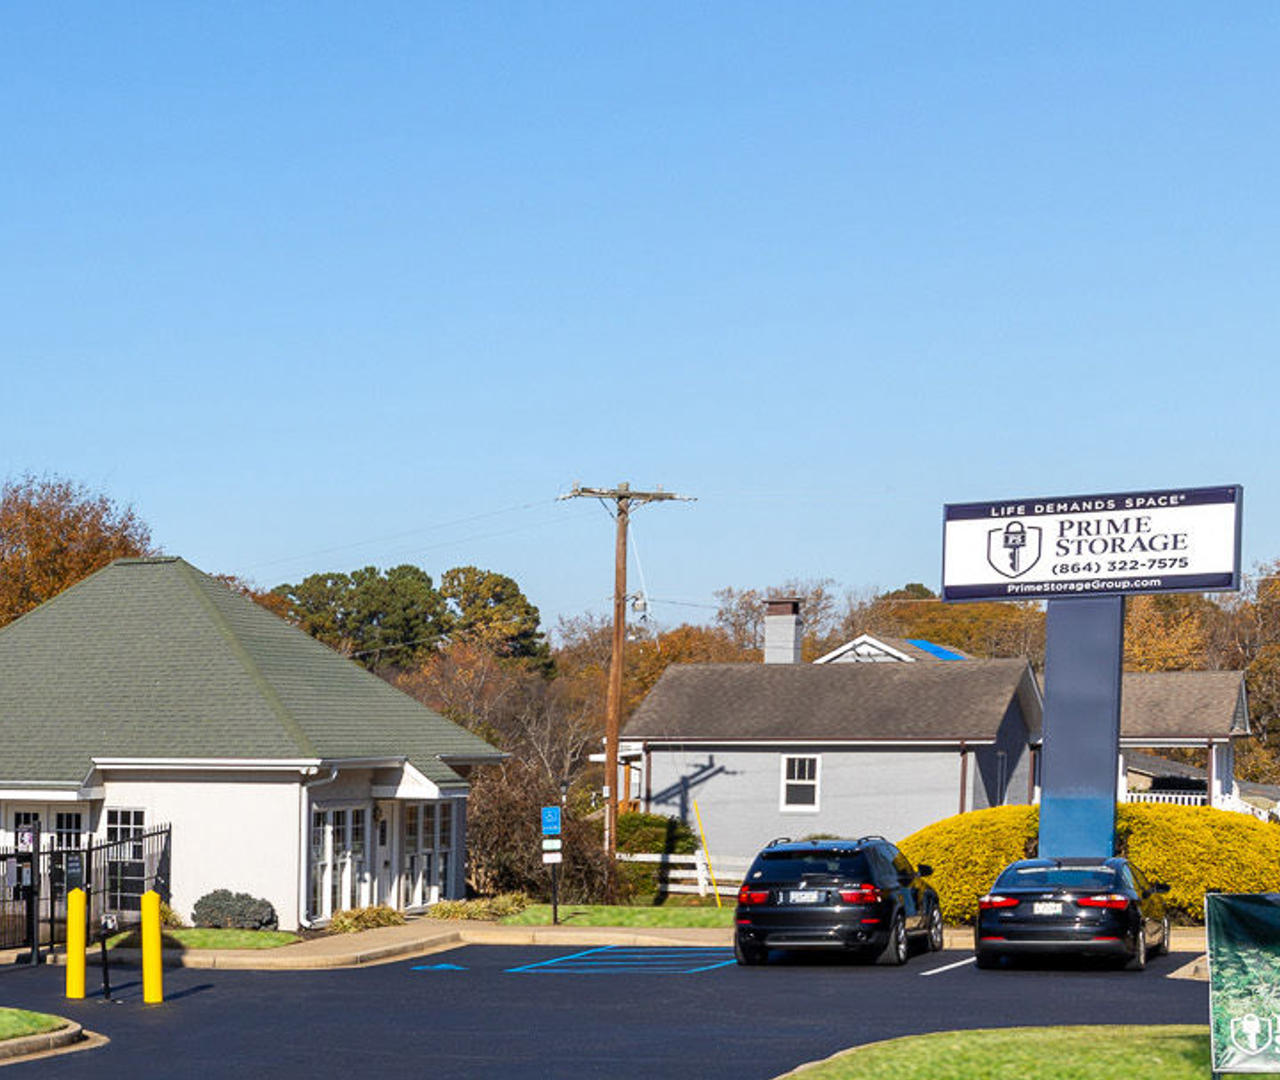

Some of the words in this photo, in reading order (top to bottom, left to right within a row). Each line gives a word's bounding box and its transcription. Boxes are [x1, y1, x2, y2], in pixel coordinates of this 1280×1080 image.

[991, 505, 1026, 517] LIFE
[1034, 499, 1116, 514] DEMANDS
[1058, 516, 1152, 537] PRIME
[1055, 533, 1188, 557] STORAGE
[1051, 562, 1101, 575] (864)
[1108, 557, 1189, 572] 322-7575
[1007, 579, 1161, 593] PrimeStorageGroup.com
